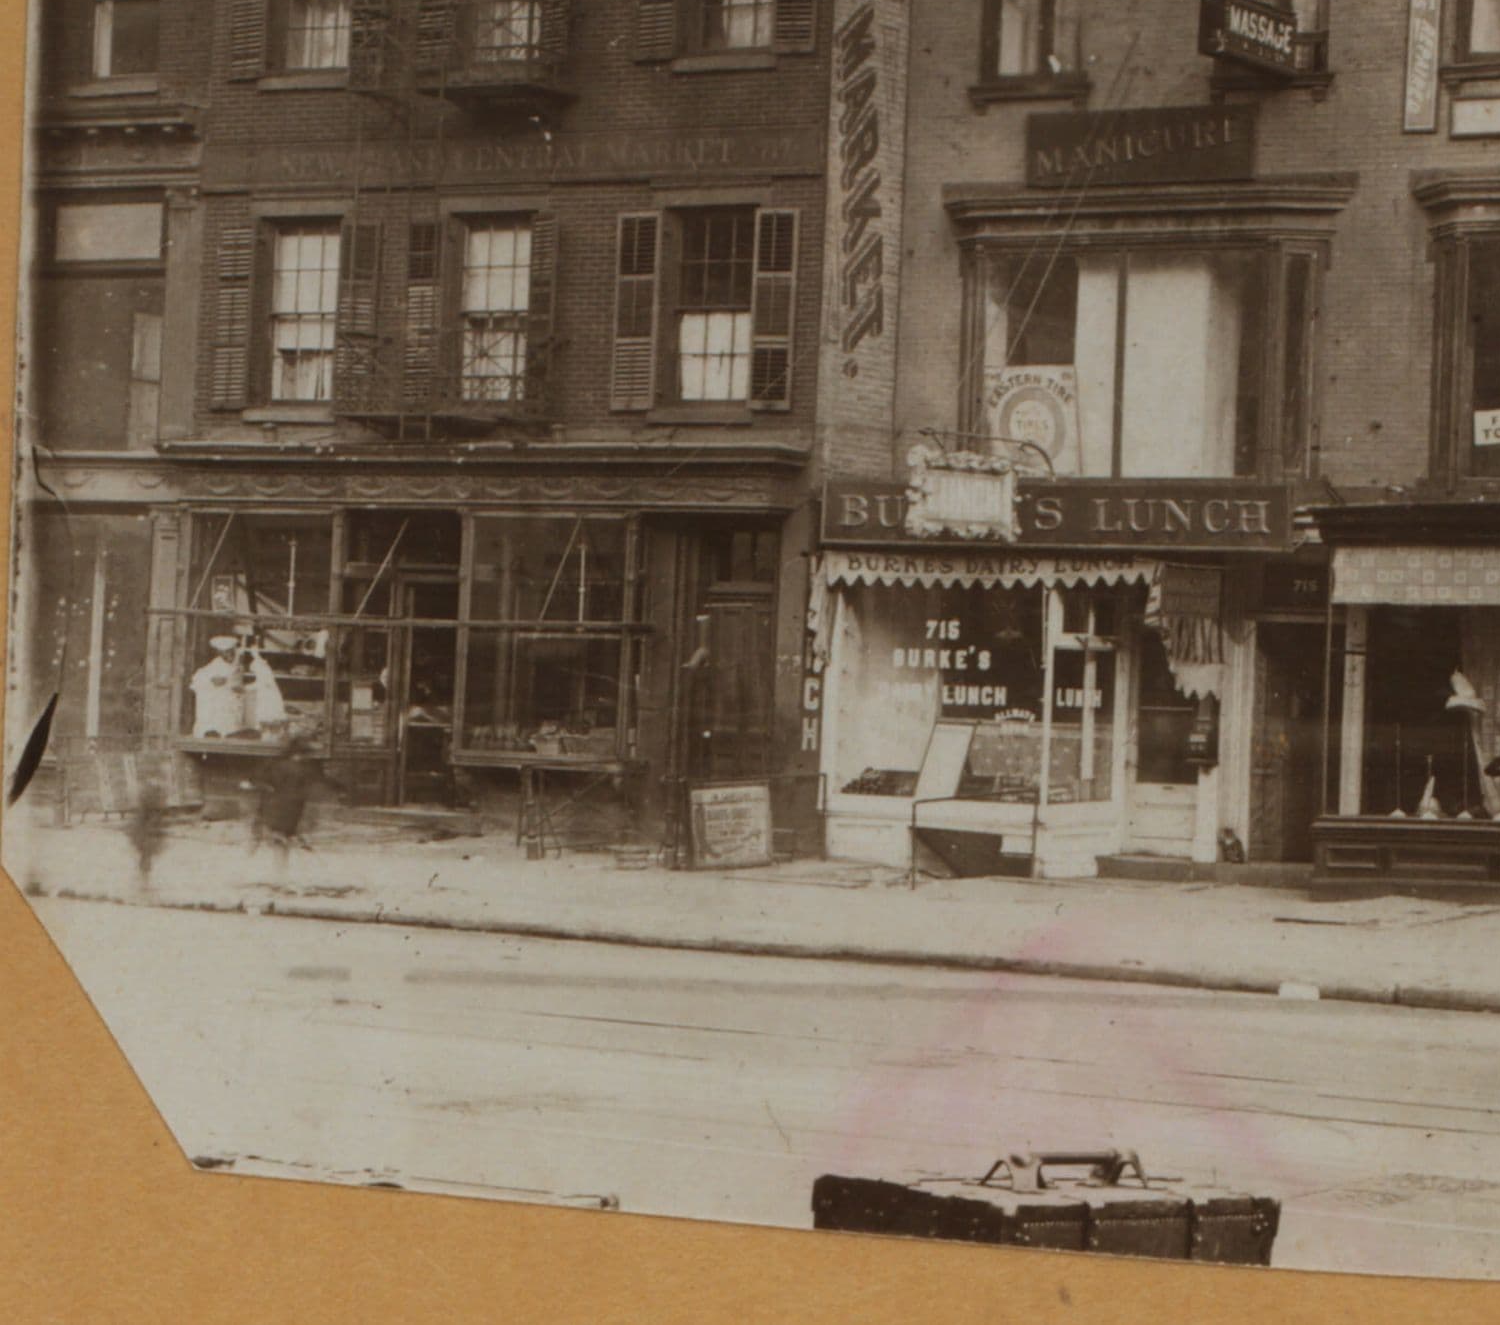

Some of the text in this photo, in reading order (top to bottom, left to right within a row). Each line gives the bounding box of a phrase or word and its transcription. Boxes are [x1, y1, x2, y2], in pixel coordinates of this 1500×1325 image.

[1229, 4, 1293, 53] MASSAGE
[988, 373, 1073, 408] EASTERN TIRE
[841, 493, 1272, 535] BU'S LUNCH
[893, 645, 991, 671] BURKE'S
[943, 686, 1007, 706] LUNCH
